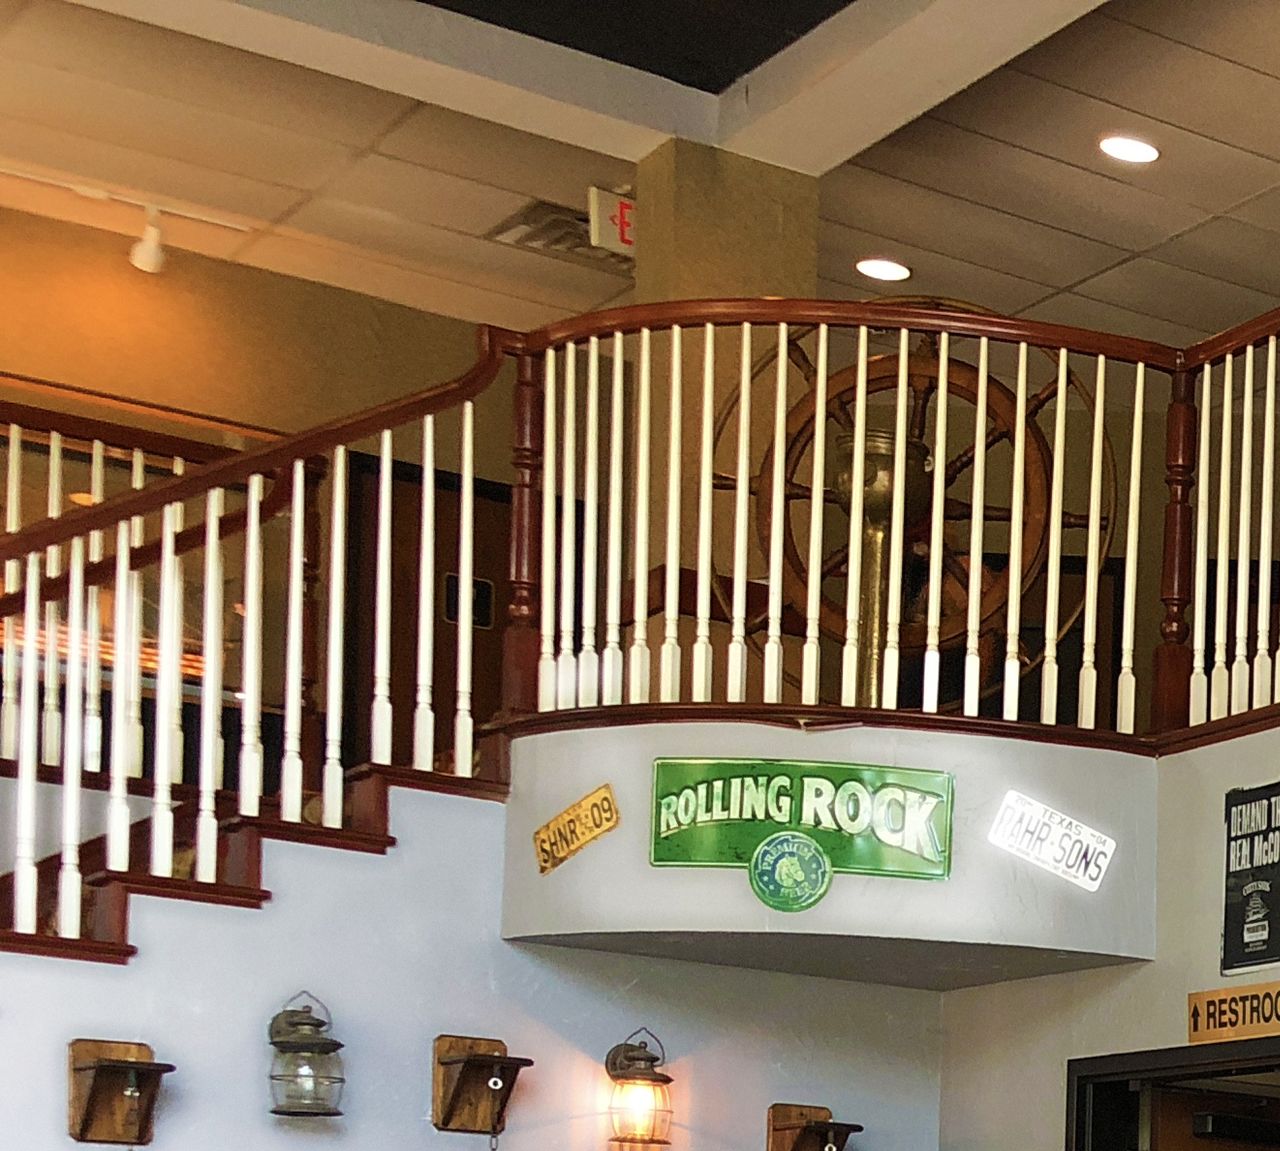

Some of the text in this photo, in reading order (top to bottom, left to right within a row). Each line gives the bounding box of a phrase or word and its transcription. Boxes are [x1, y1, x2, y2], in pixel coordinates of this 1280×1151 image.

[540, 796, 614, 864] SHNR 09
[660, 774, 792, 838] ROLLING
[802, 776, 948, 862] ROCK
[1041, 807, 1083, 836] TEXAS
[1230, 798, 1269, 838] DEMAND
[1052, 832, 1108, 881] SONS
[1229, 836, 1252, 872] REAL
